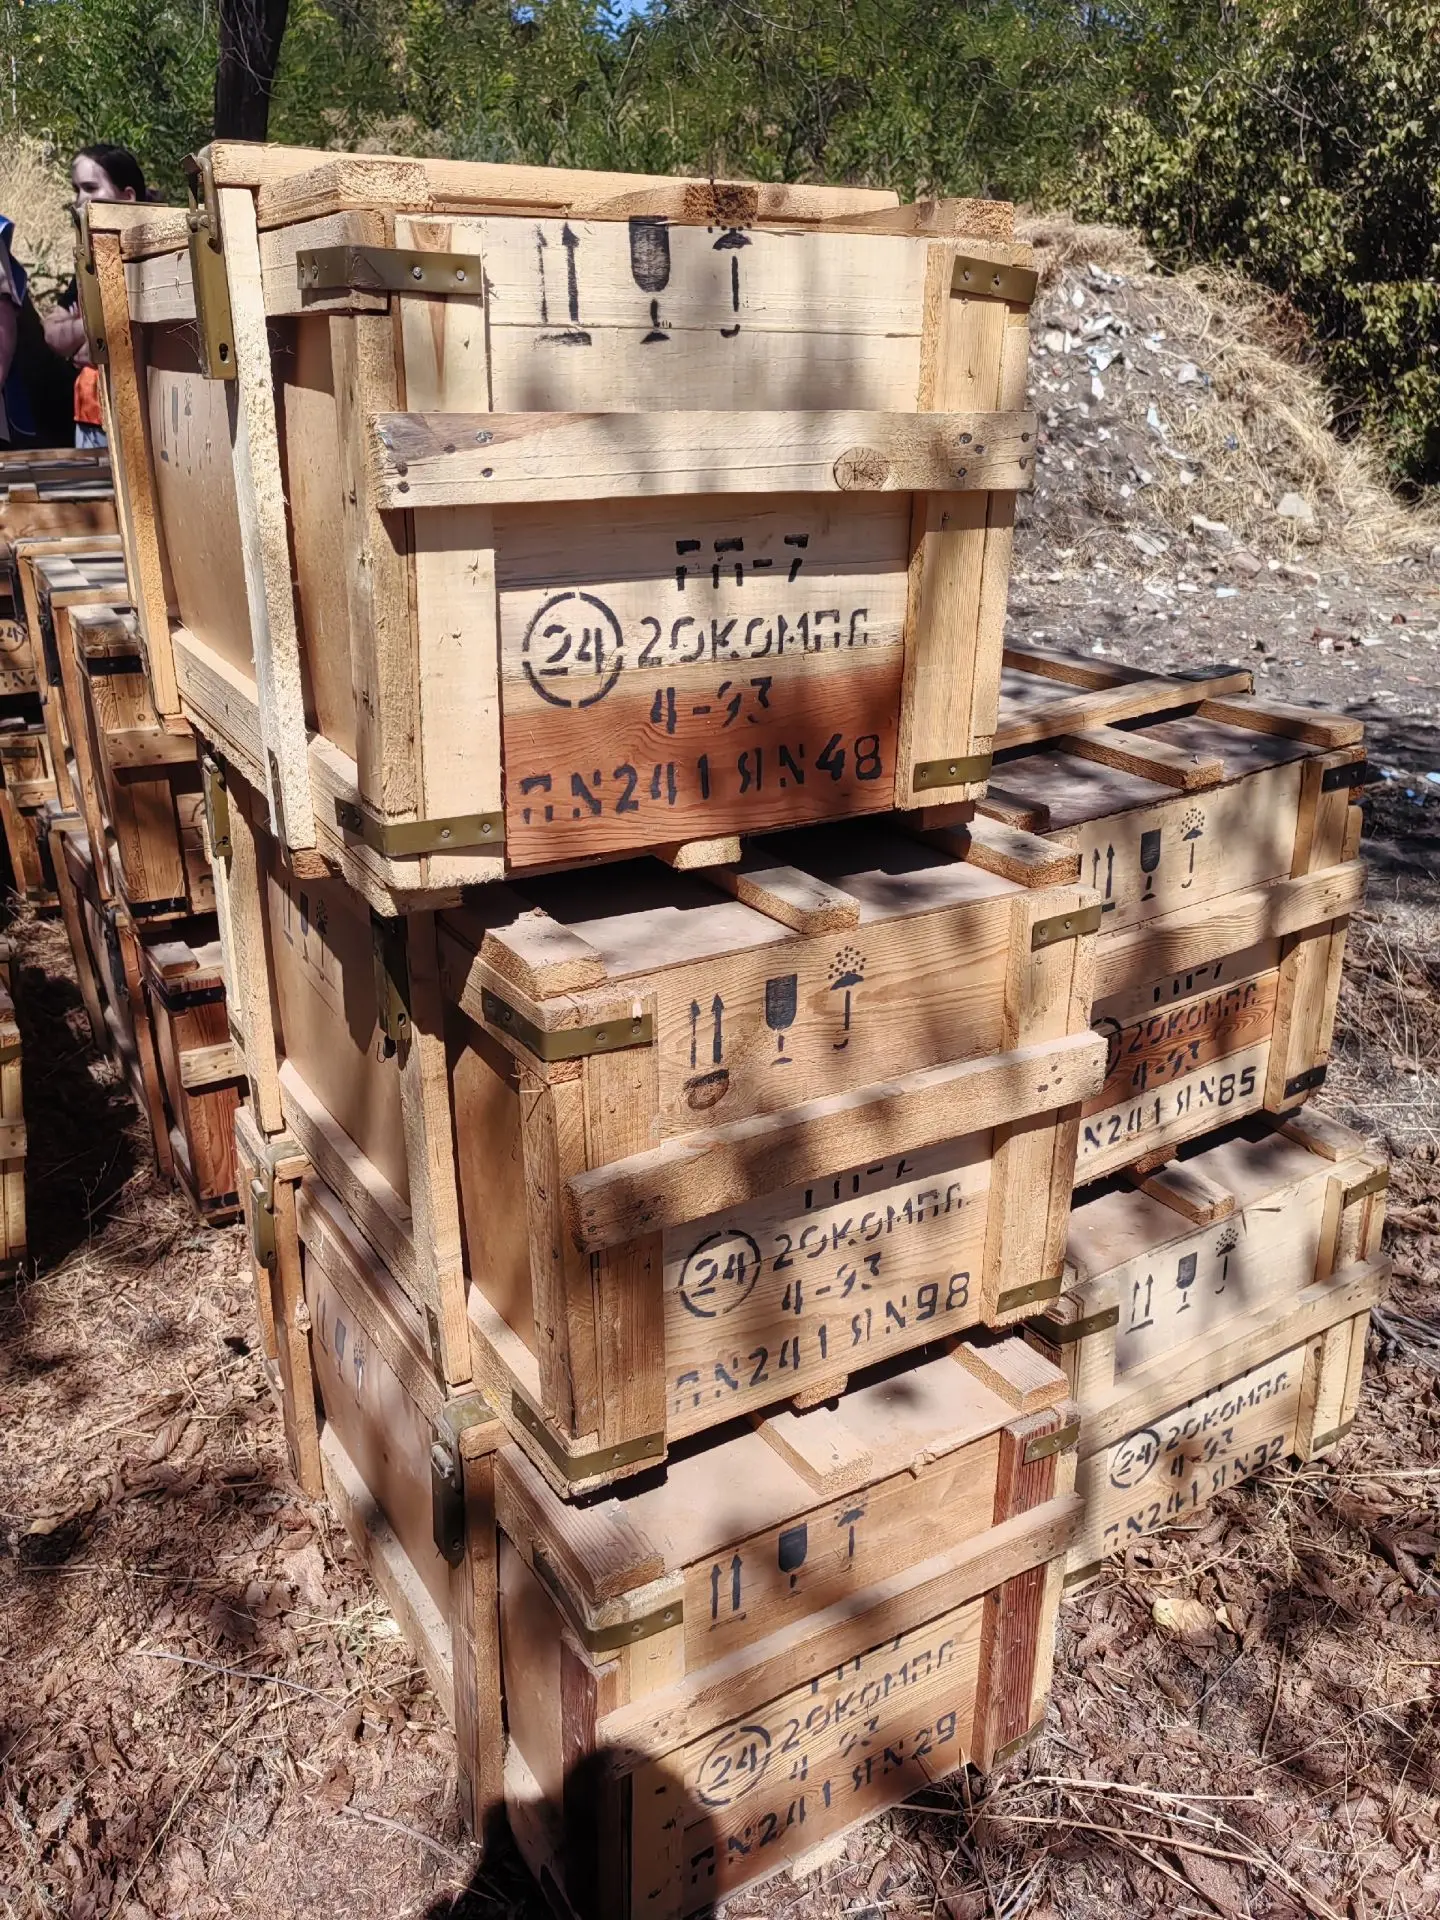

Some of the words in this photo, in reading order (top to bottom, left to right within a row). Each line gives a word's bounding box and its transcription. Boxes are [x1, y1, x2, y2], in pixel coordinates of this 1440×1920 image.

[539, 624, 603, 676] 24
[691, 1252, 747, 1298] 24
[1116, 1442, 1153, 1477] 24
[707, 1743, 758, 1792] 24
